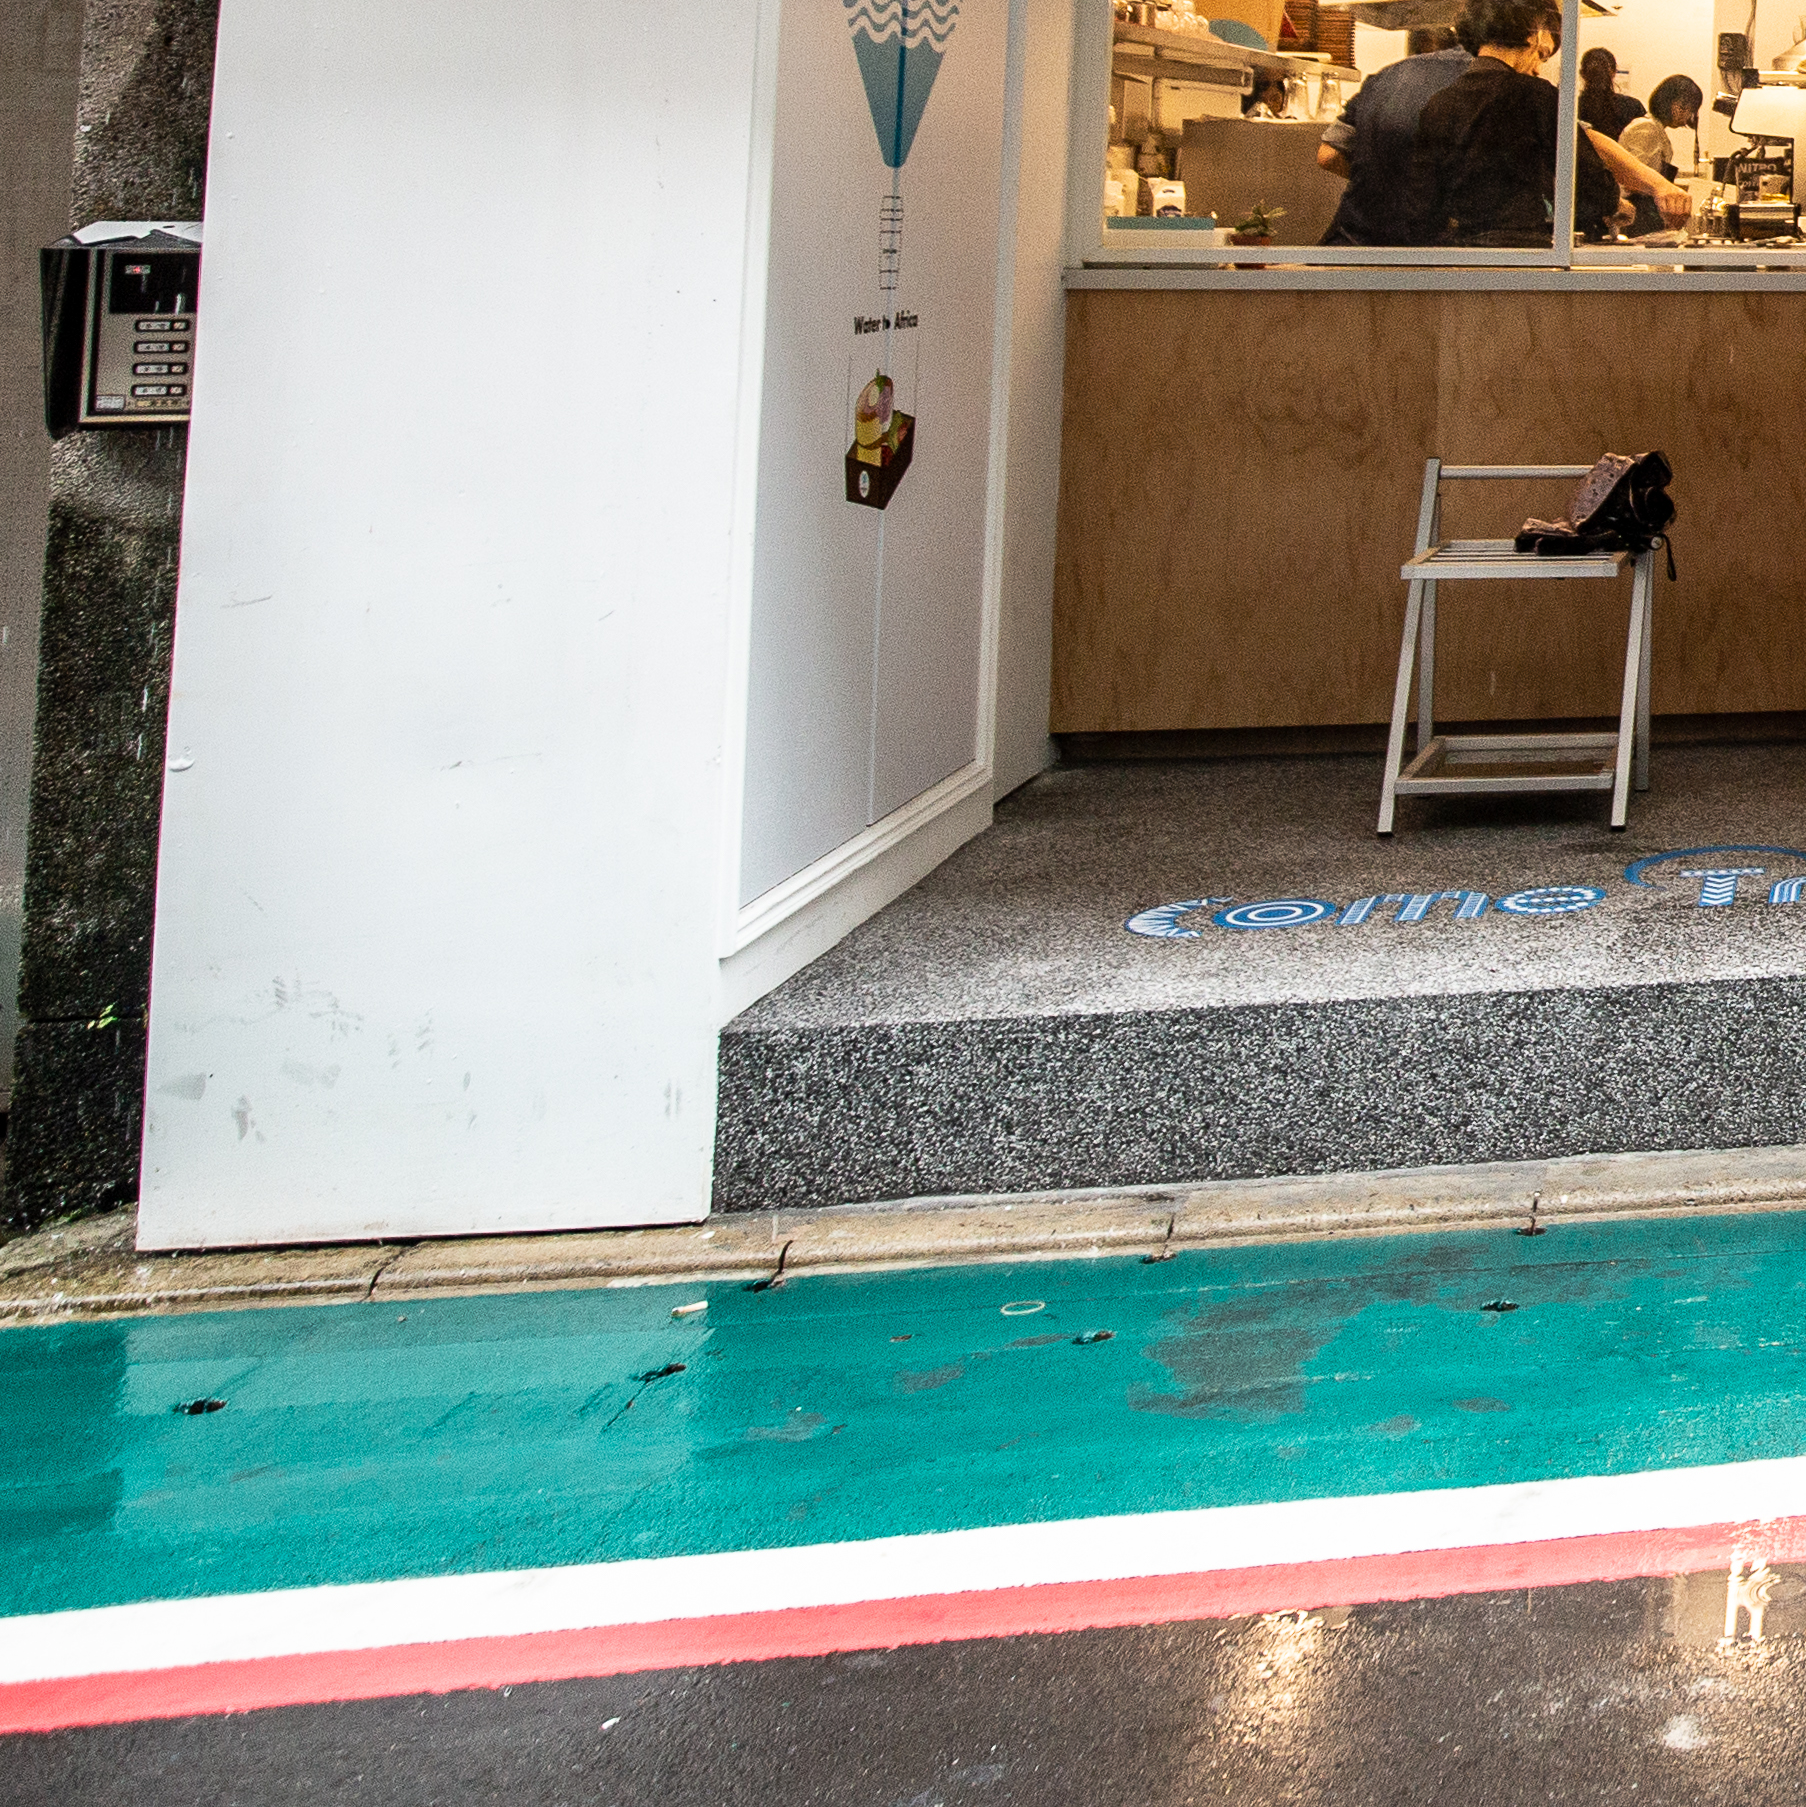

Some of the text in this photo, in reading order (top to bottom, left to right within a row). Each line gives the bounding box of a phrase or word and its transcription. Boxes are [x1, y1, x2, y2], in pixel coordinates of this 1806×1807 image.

[1739, 162, 1778, 174] NITRO
[853, 315, 881, 335] Water
[894, 310, 918, 330] Africa
[1124, 885, 1606, 939] Come
